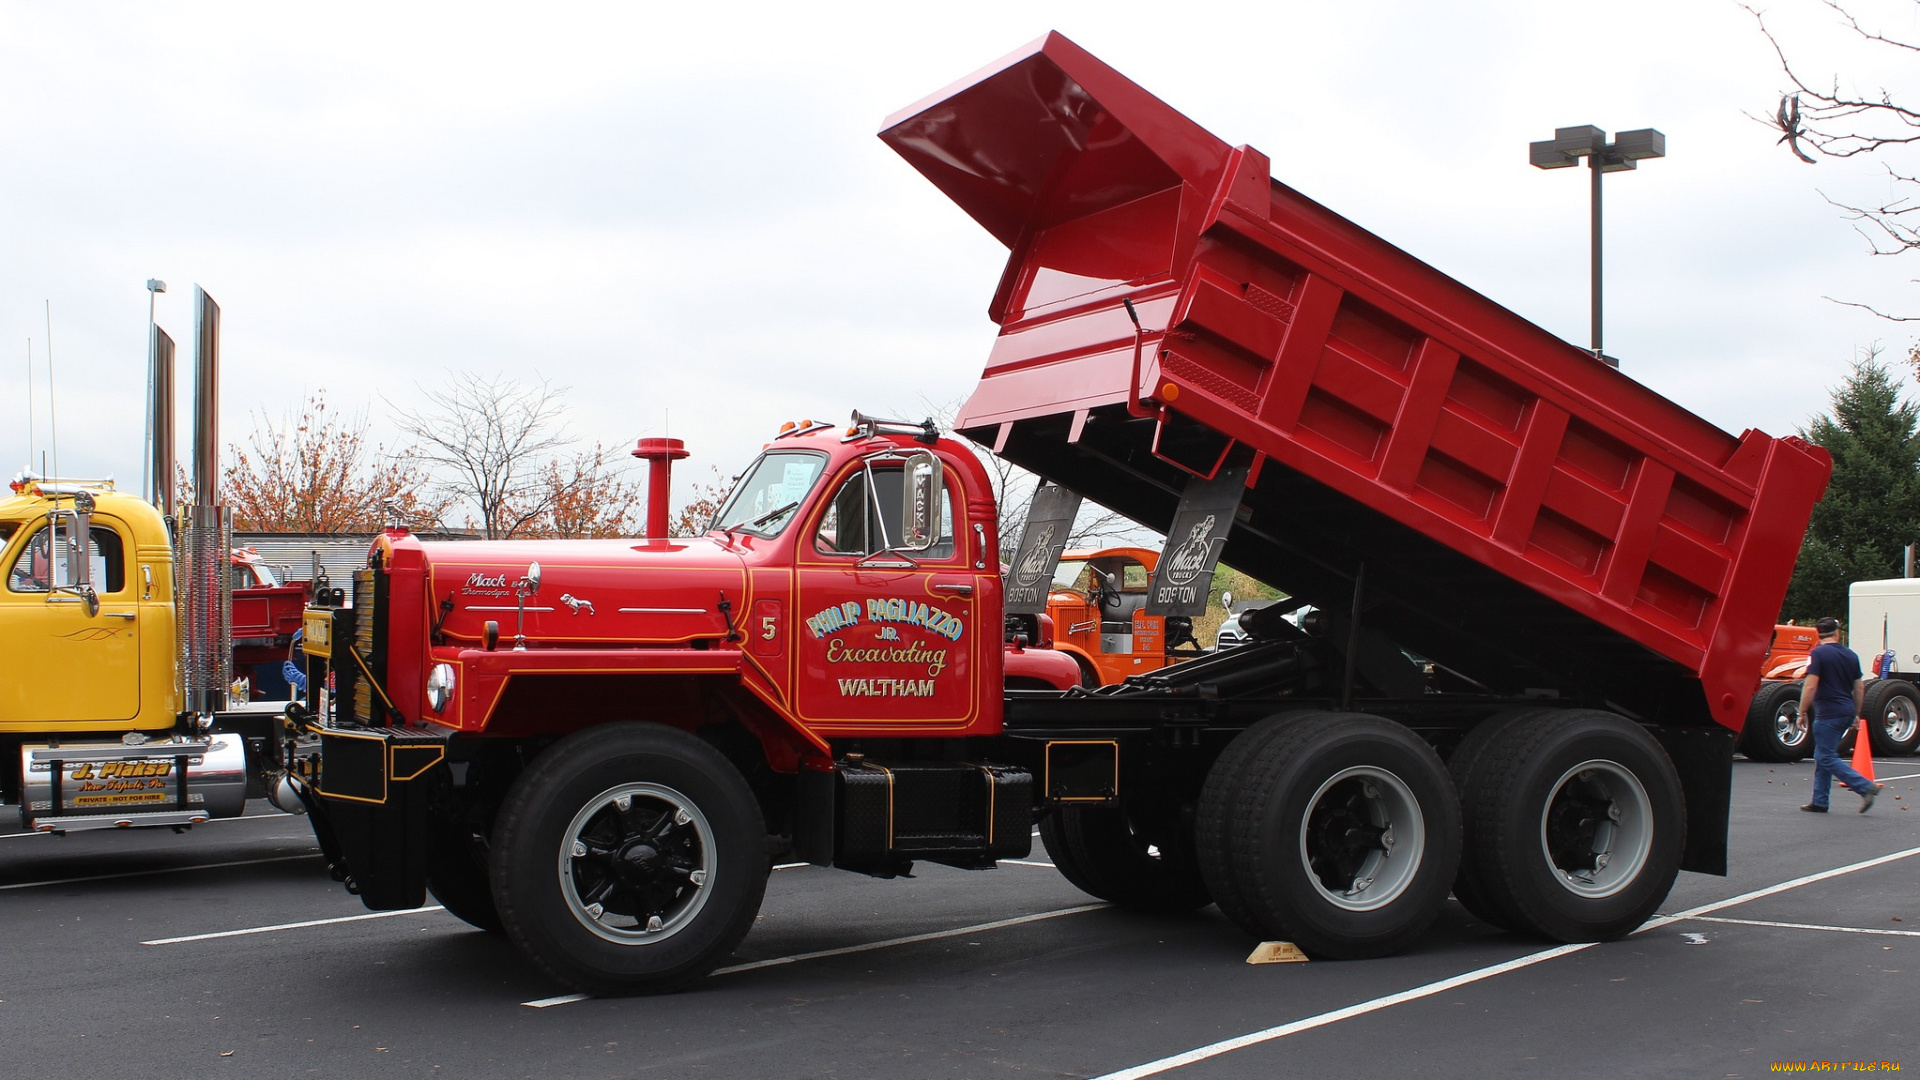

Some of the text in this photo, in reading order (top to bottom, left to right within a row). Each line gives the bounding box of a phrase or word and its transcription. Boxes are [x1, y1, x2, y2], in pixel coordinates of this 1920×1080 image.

[1019, 556, 1046, 575] Mack
[1169, 550, 1202, 572] Mack
[464, 573, 506, 587] Mack
[1020, 574, 1038, 582] TRUCKS
[1172, 571, 1193, 580] TRUCKS
[461, 588, 510, 599] Thermodyne
[1008, 587, 1039, 603] BOSTON
[1157, 586, 1198, 604] BOSTON
[761, 616, 777, 641] 5
[806, 598, 964, 642] PHILIP PAGLIAZZO
[874, 626, 900, 641] JR.
[826, 638, 948, 678] Excavating
[838, 678, 936, 698] WALTHAM
[71, 761, 171, 780] J. Plaksa
[77, 781, 105, 792] New
